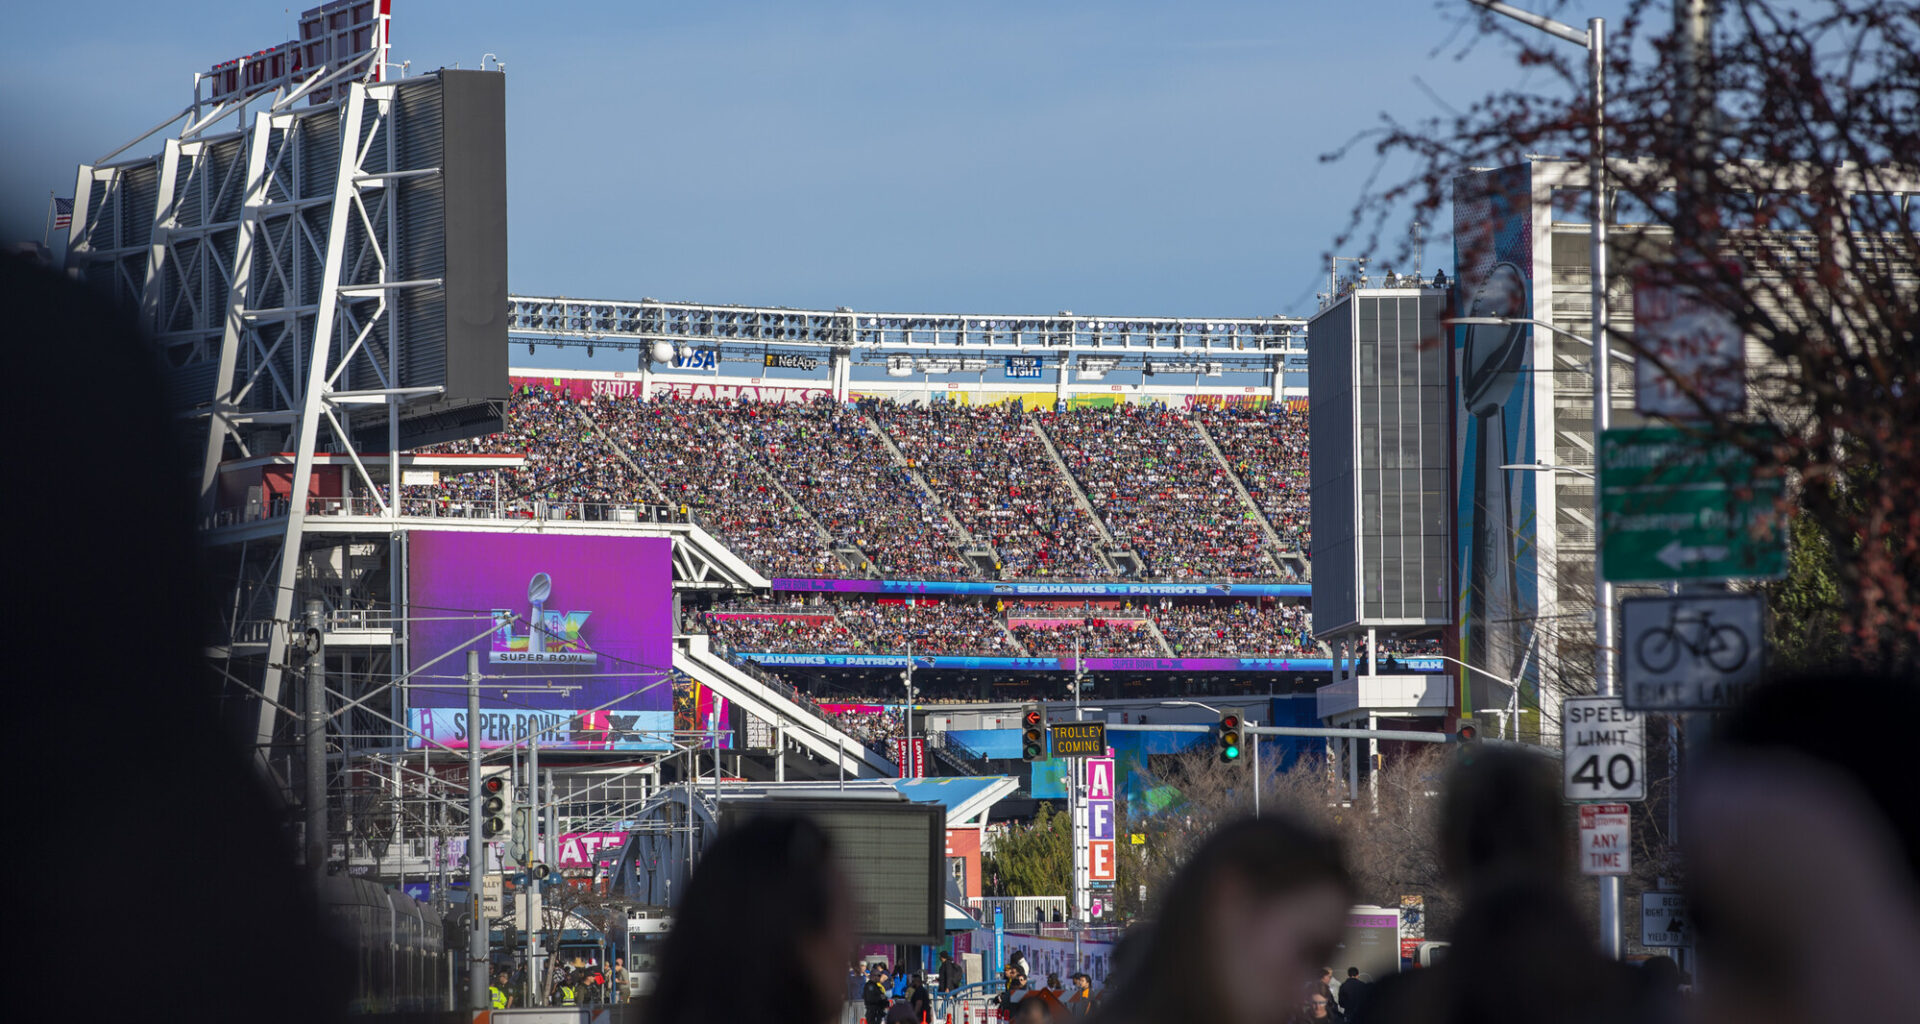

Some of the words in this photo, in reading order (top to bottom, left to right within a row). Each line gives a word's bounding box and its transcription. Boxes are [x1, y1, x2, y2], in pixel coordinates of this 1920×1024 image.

[674, 349, 715, 368] VISA
[778, 355, 818, 369] NetApp
[1006, 366, 1040, 376] LIGHT
[591, 380, 636, 399] SEATTLE
[650, 382, 828, 405] SEAHAWKS
[811, 581, 835, 590] LX
[1017, 585, 1106, 594] SEAHAWKS
[1129, 586, 1208, 594] PATRIOTS
[500, 653, 544, 662] SUPER
[549, 653, 587, 663] BOWL
[747, 656, 826, 665] SEAHAWKS
[828, 657, 845, 665] VS
[1112, 659, 1134, 669] SUPER
[1156, 660, 1184, 669] LX
[1571, 707, 1635, 723] SPEED
[454, 712, 510, 741] SPER
[1054, 726, 1102, 739] TROLLEY
[1577, 730, 1628, 746] LIMIT
[1058, 740, 1100, 753] COMING
[1571, 754, 1635, 791] 40
[1591, 833, 1620, 849] ANY
[1590, 853, 1622, 867] TIME
[482, 881, 500, 889] LLEY
[1645, 908, 1664, 917] RIGHT
[1647, 932, 1668, 942] YIELD
[1669, 932, 1679, 942] TO
